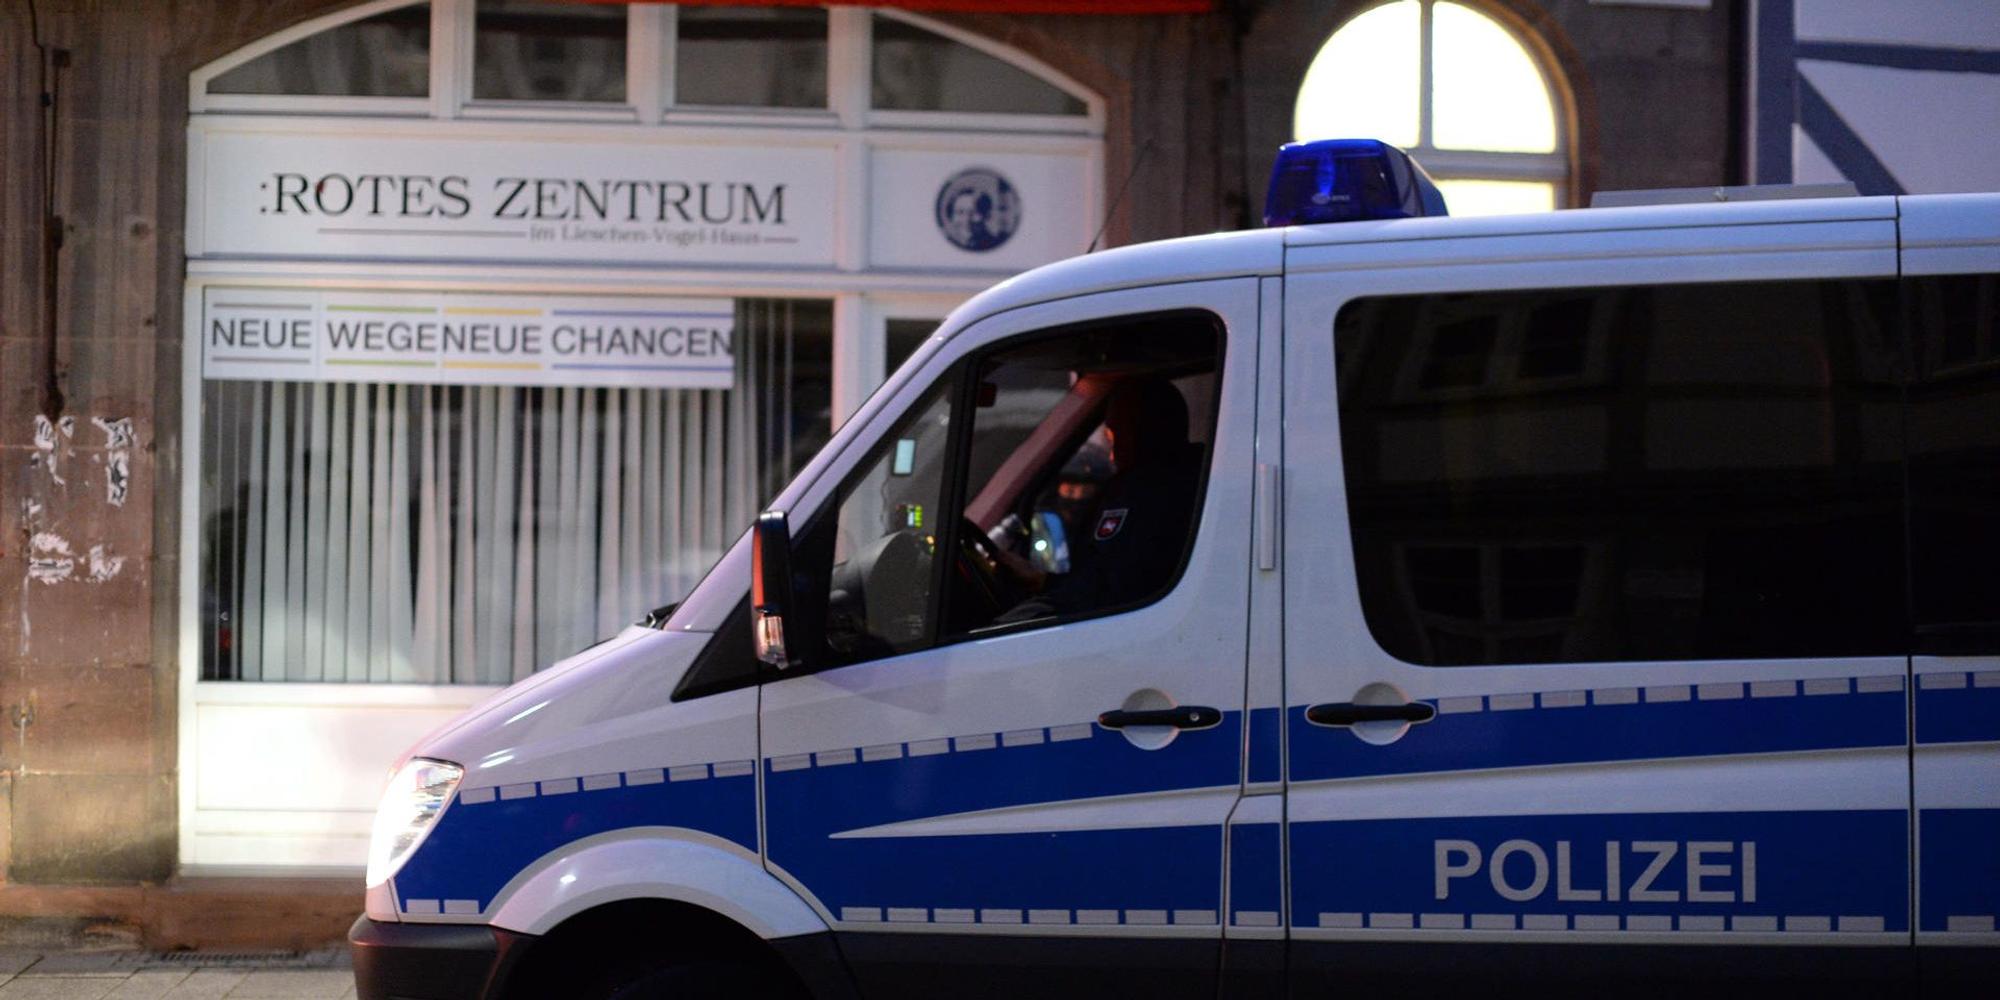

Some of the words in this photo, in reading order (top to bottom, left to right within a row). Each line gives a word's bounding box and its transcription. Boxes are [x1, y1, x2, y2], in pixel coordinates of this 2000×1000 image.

[492, 177, 789, 225] ZENTRUM
[211, 319, 311, 349] NEUE
[326, 322, 437, 351] WEGE
[442, 323, 541, 353] NEUE
[551, 325, 735, 356] CHANCEN
[1434, 839, 1757, 903] POLIZEI
